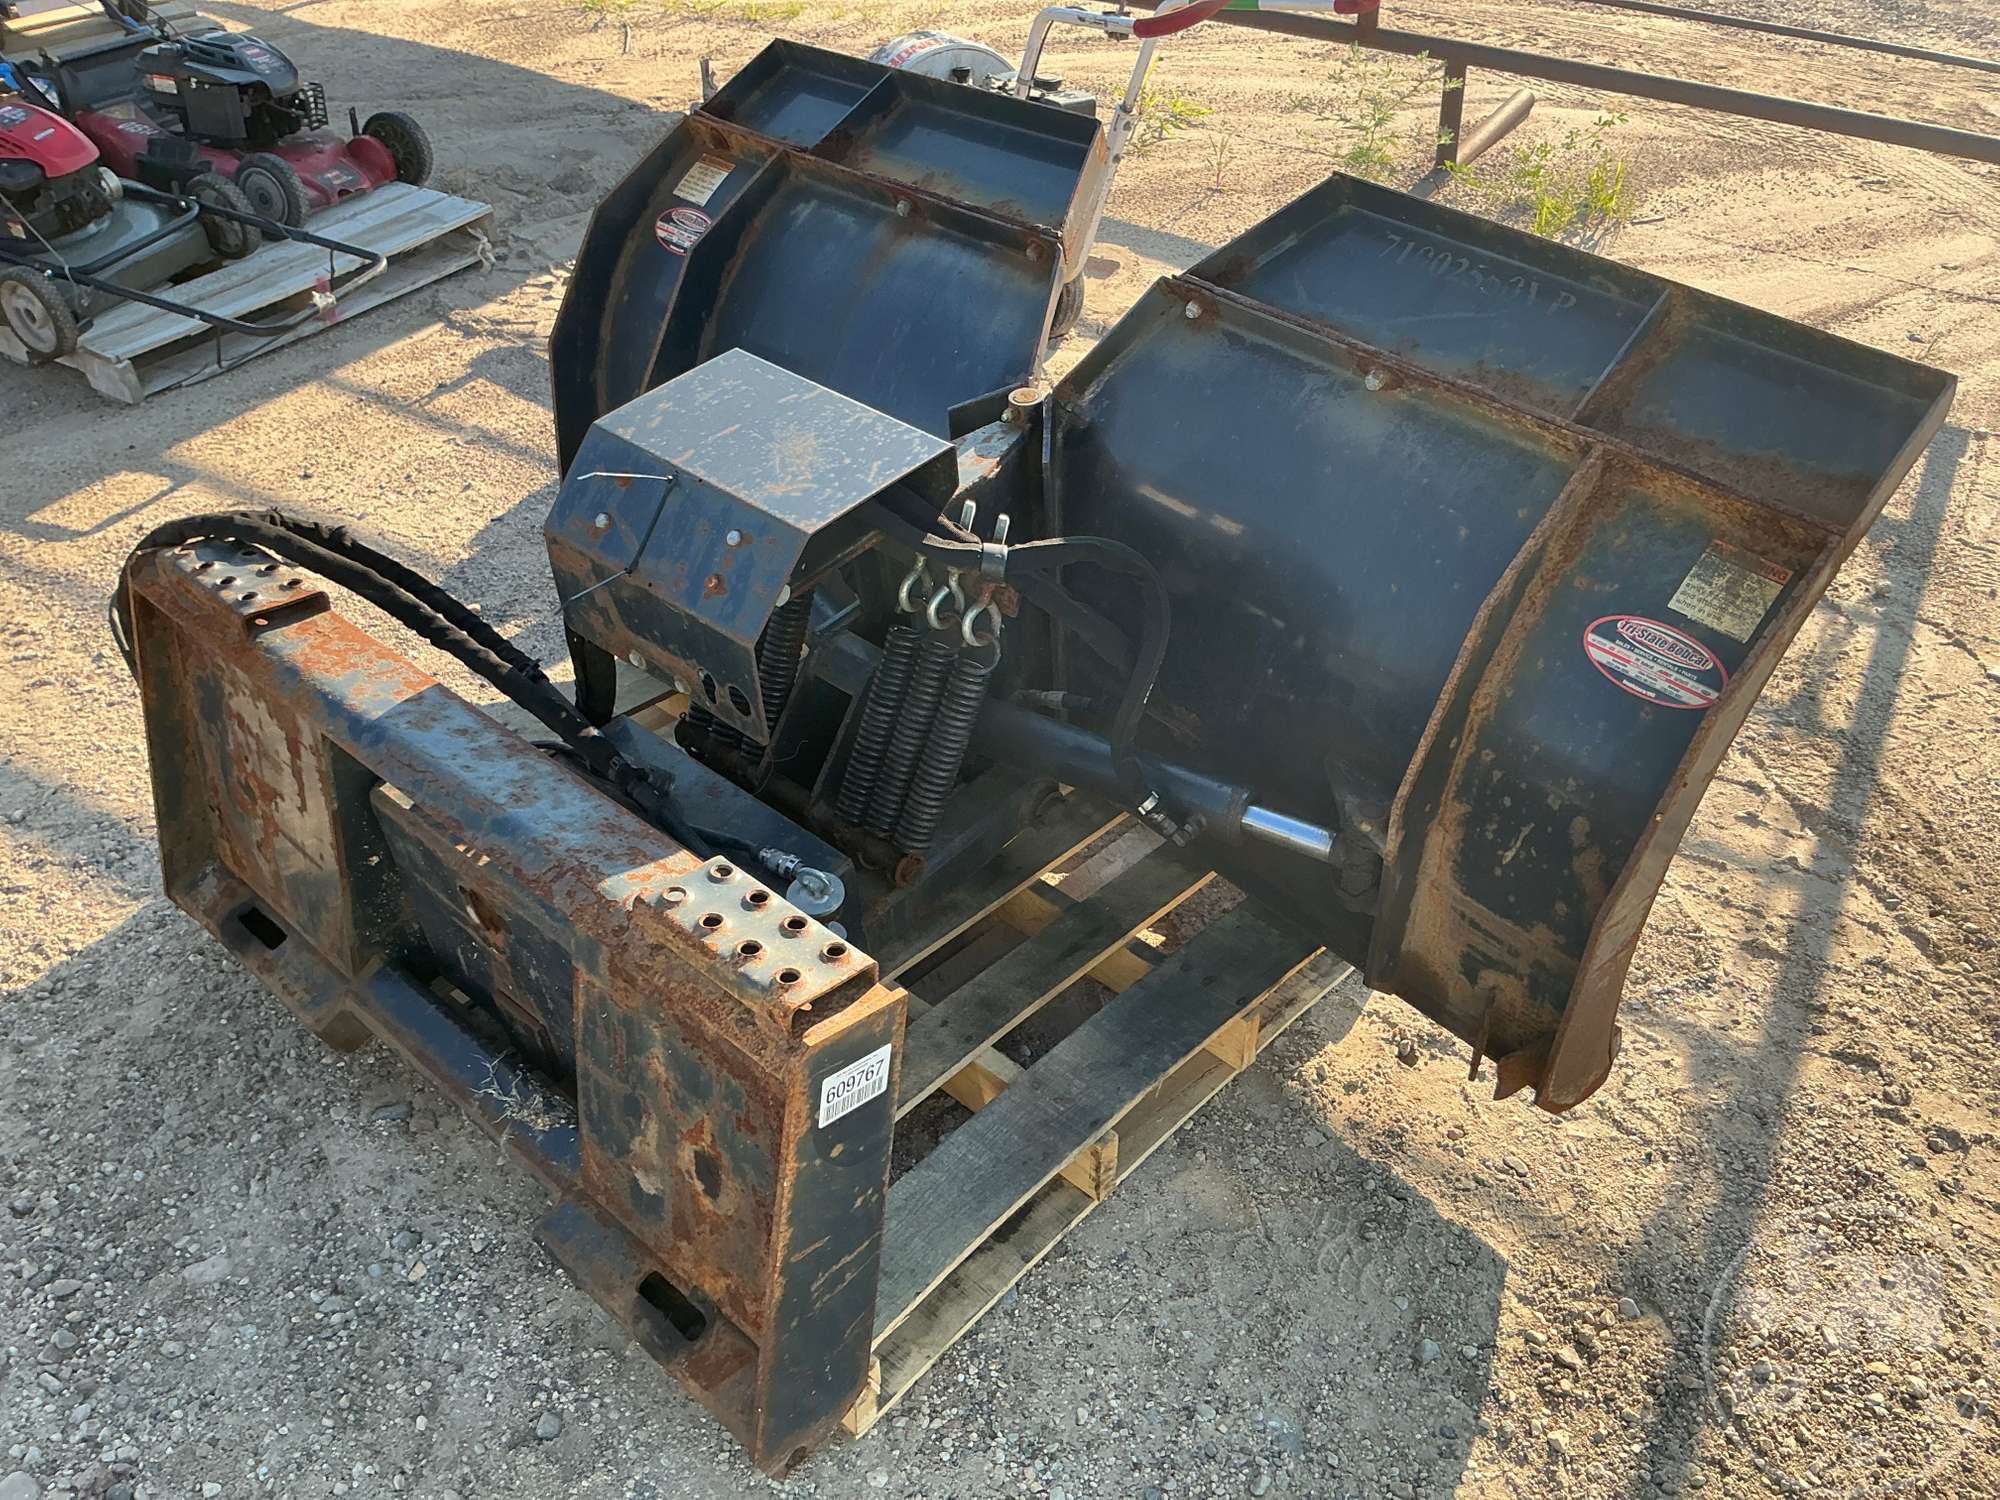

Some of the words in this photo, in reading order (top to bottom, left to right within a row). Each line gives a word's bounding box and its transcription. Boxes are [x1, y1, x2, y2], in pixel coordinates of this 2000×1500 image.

[1620, 619, 1668, 649] Tri-State
[1665, 640, 1711, 669] Bobcat
[826, 1059, 885, 1104] 609767
